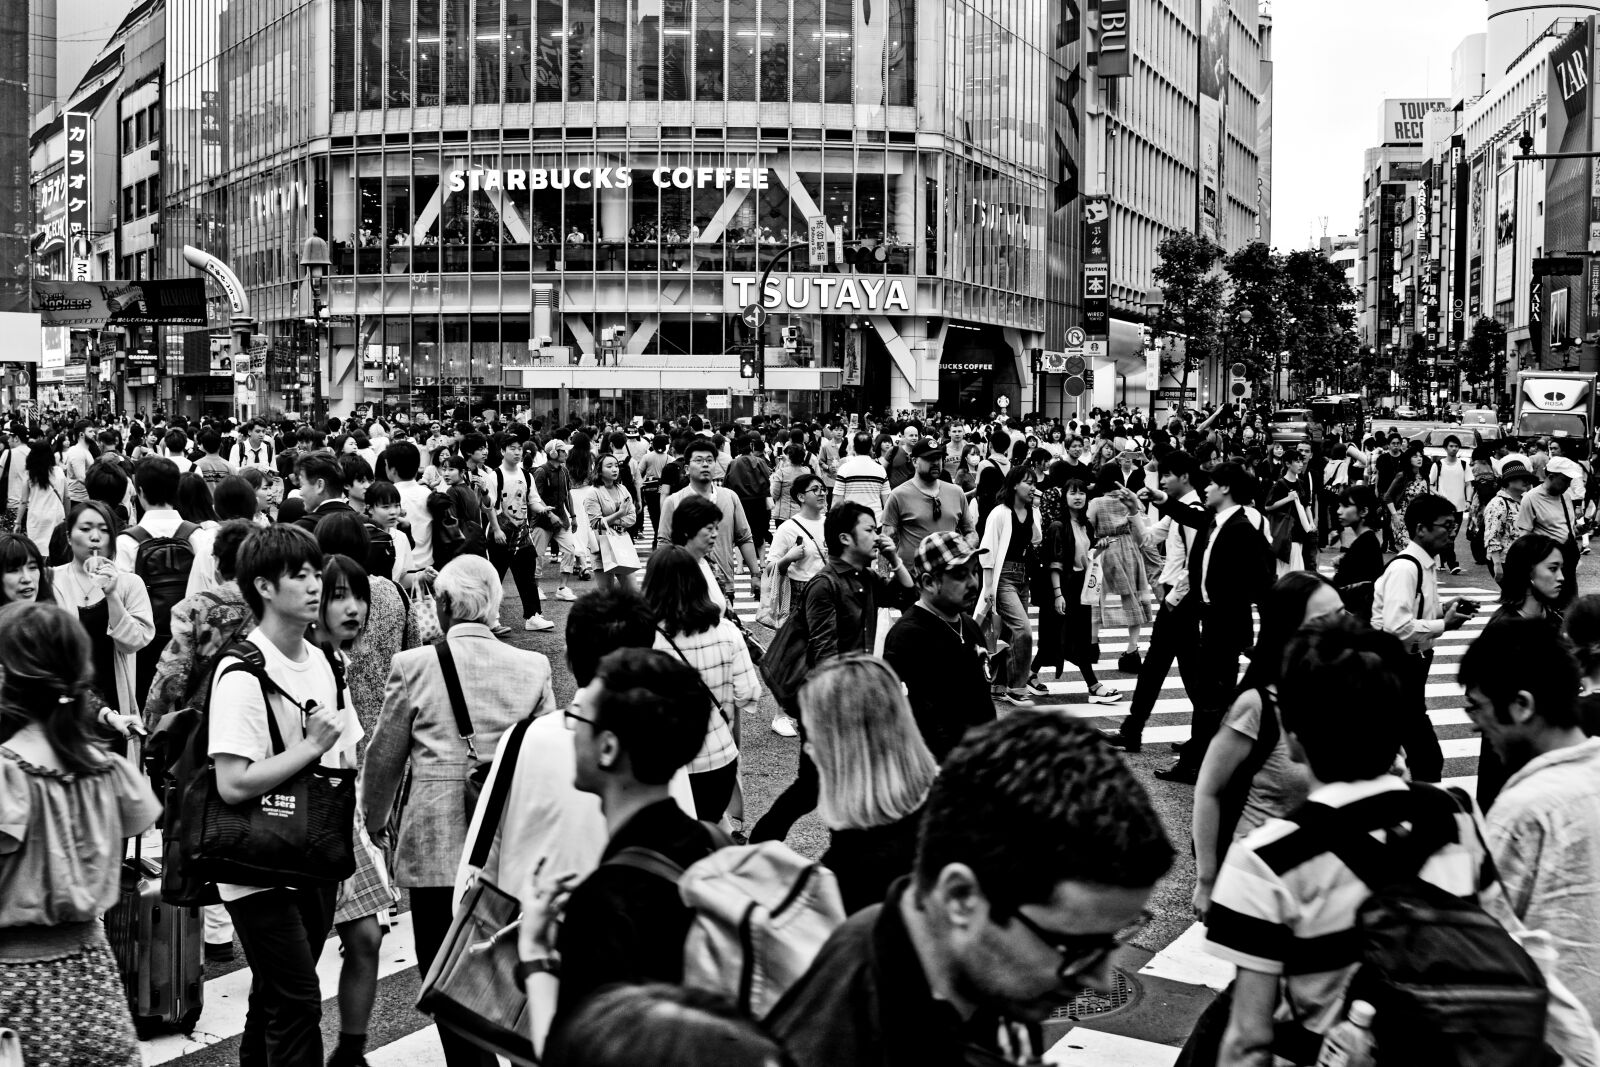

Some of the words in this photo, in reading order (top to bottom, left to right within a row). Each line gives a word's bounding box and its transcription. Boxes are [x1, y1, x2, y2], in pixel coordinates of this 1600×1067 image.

[1100, 0, 1126, 55] BU
[1556, 46, 1588, 101] ZAR
[69, 126, 86, 213] カラオケ
[449, 167, 633, 192] STARBUCKS
[652, 167, 769, 189] COFFEE
[1416, 180, 1426, 240] KARAOKE
[816, 219, 826, 262] 渋谷駅前
[732, 277, 909, 310] TSUTAYA
[1088, 277, 1104, 294] 本
[1531, 284, 1540, 322] ZARA
[261, 795, 272, 806] K
[274, 794, 296, 802] sera
[274, 800, 296, 809] sera
